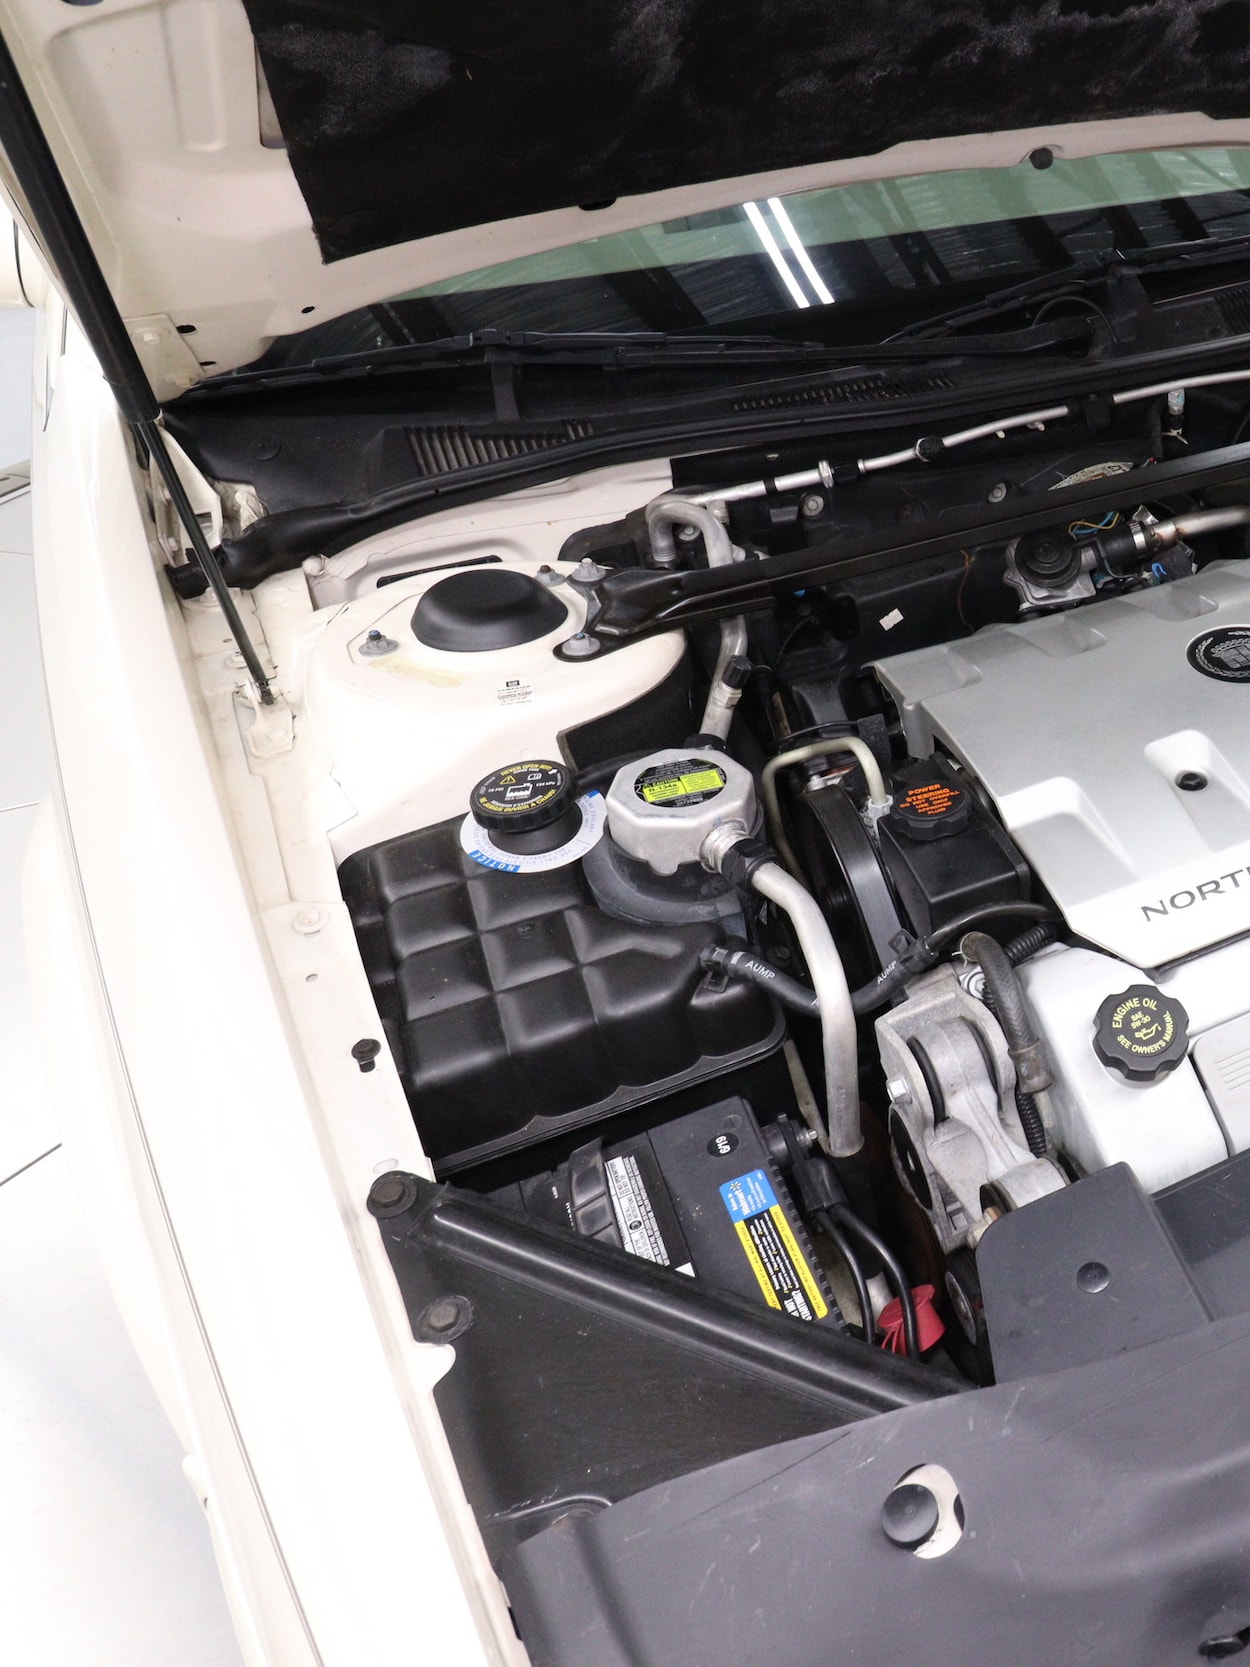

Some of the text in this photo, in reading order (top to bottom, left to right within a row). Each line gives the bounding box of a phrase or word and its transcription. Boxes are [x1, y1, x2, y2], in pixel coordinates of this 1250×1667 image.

[499, 765, 522, 775] NEVER
[522, 762, 539, 770] OPEN
[905, 788, 950, 802] STEERING
[908, 784, 941, 796] POWER
[929, 790, 960, 801] OVERFILL
[503, 803, 529, 812] OUVRIR
[918, 801, 952, 813] APPROVED
[928, 807, 946, 815] FLUID
[472, 852, 514, 872] NOTICE
[745, 960, 775, 979] AUMP
[877, 960, 897, 984] AUMP
[1112, 998, 1157, 1028] ENGINE OIL
[1131, 1011, 1144, 1021] SAE
[1131, 1015, 1151, 1029] 5W-30
[1117, 1011, 1173, 1054] SEE OWNER'S MANUAL
[714, 1134, 731, 1155] 6/19
[734, 1187, 751, 1216] Walmart
[790, 1288, 812, 1322] STARTING?
